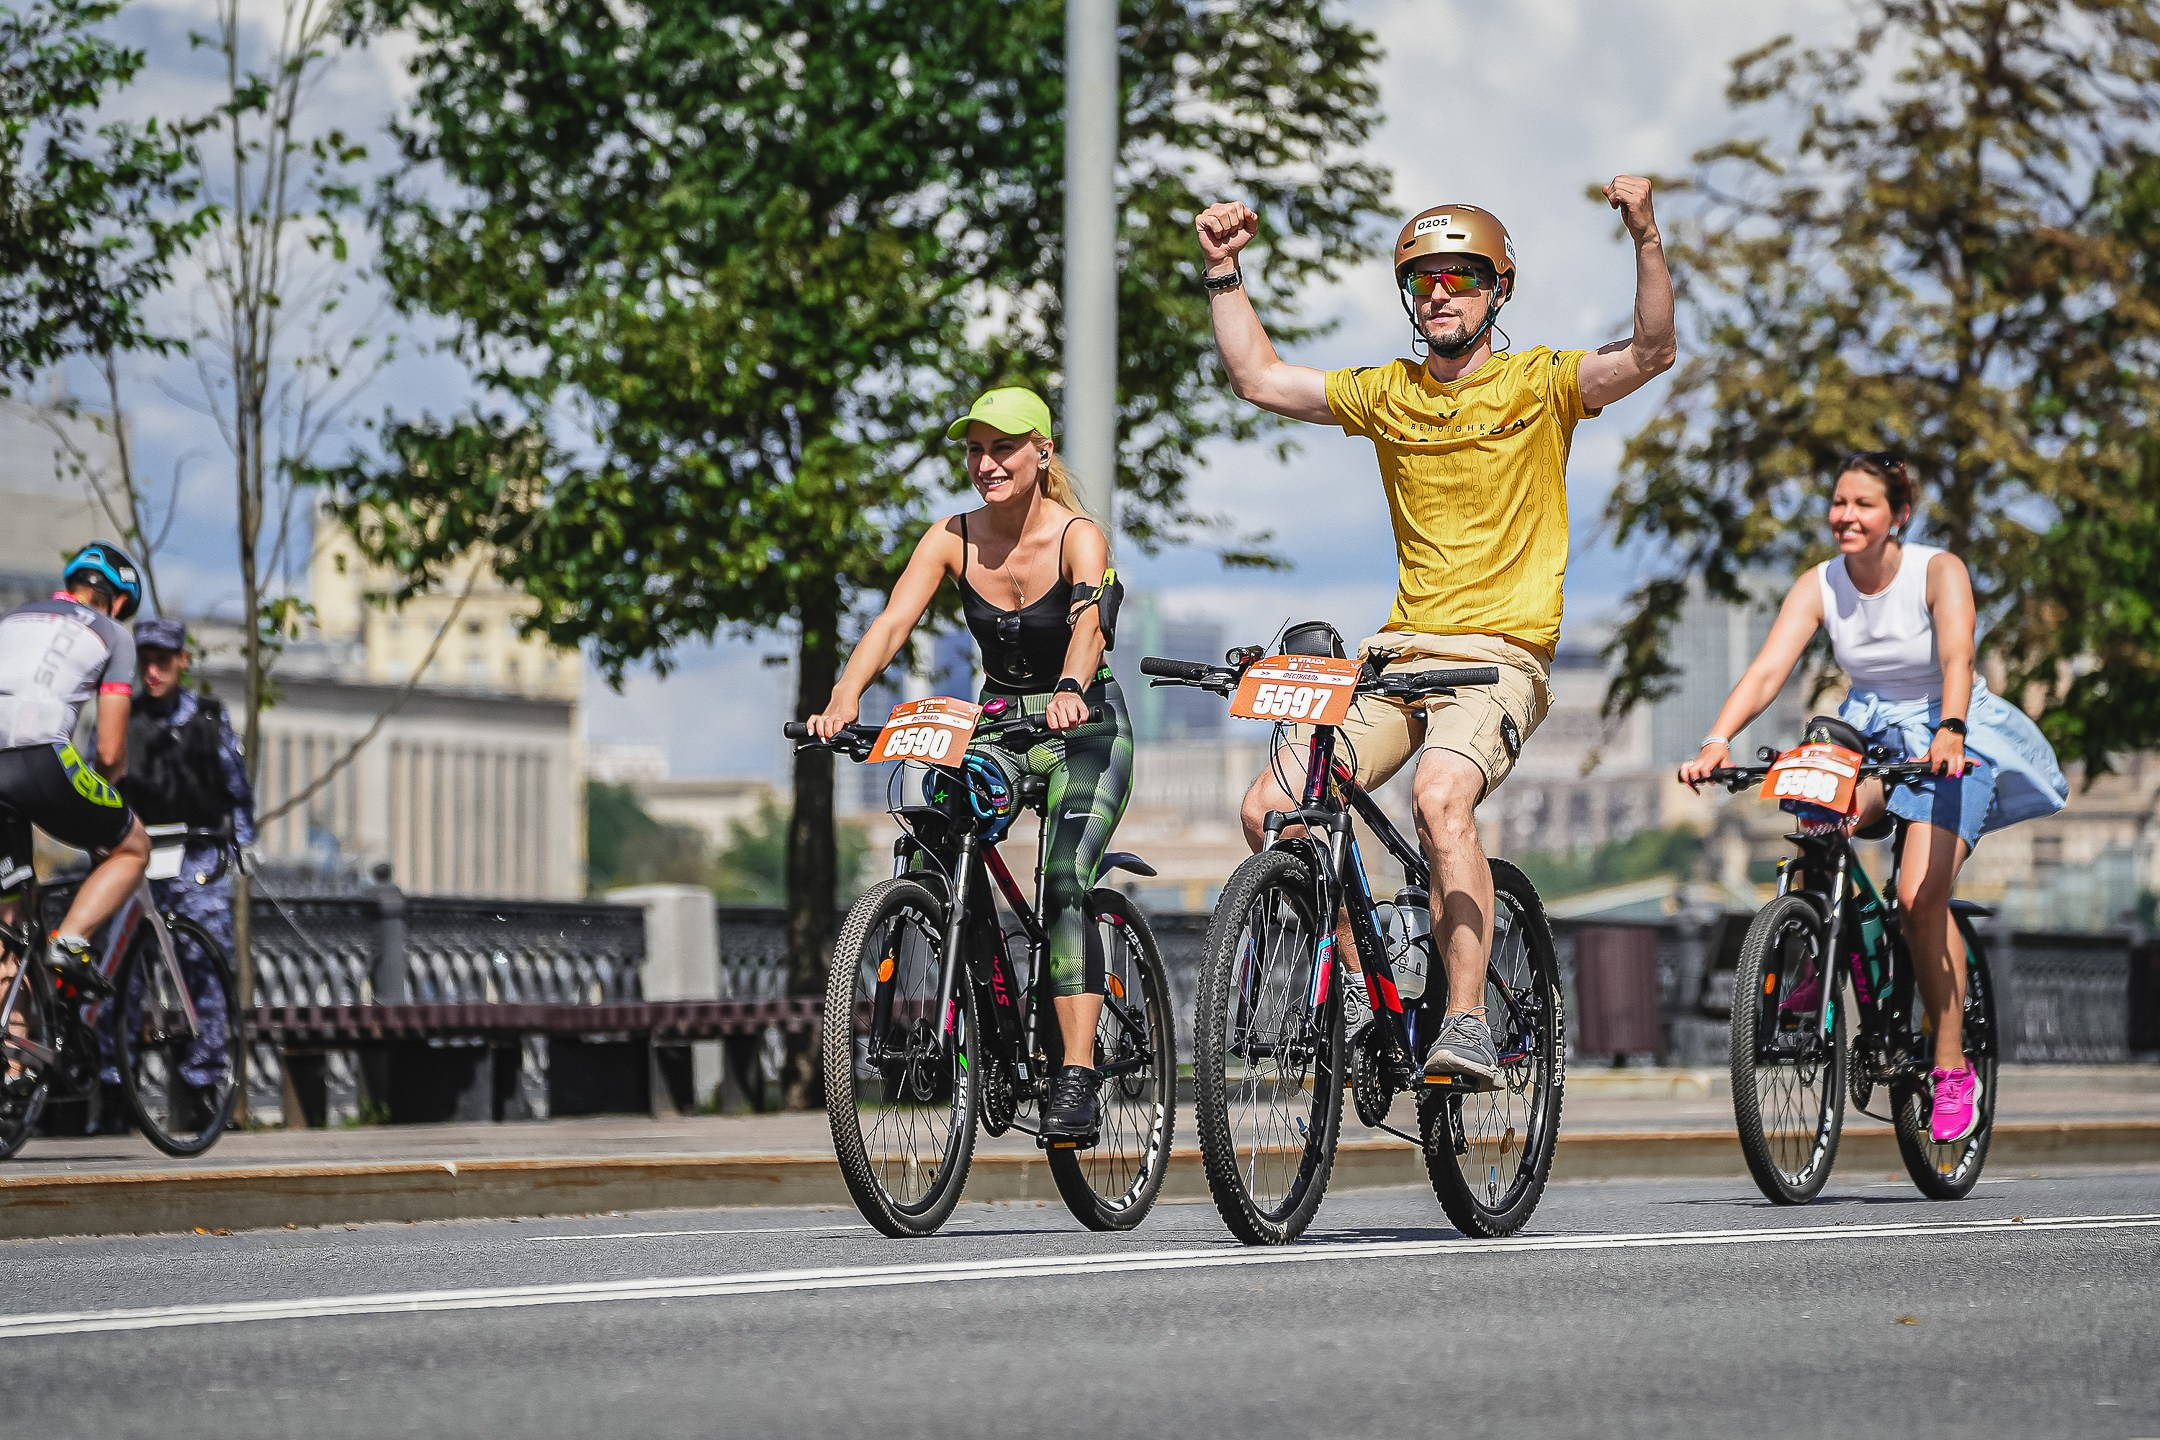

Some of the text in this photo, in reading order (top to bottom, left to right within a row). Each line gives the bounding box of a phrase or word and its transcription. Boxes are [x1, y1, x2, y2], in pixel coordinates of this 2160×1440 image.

[1417, 218, 1448, 231] 0205
[1410, 423, 1495, 433] ВЕЛОГОНК
[1251, 683, 1333, 720] 5597
[882, 726, 953, 760] 6590
